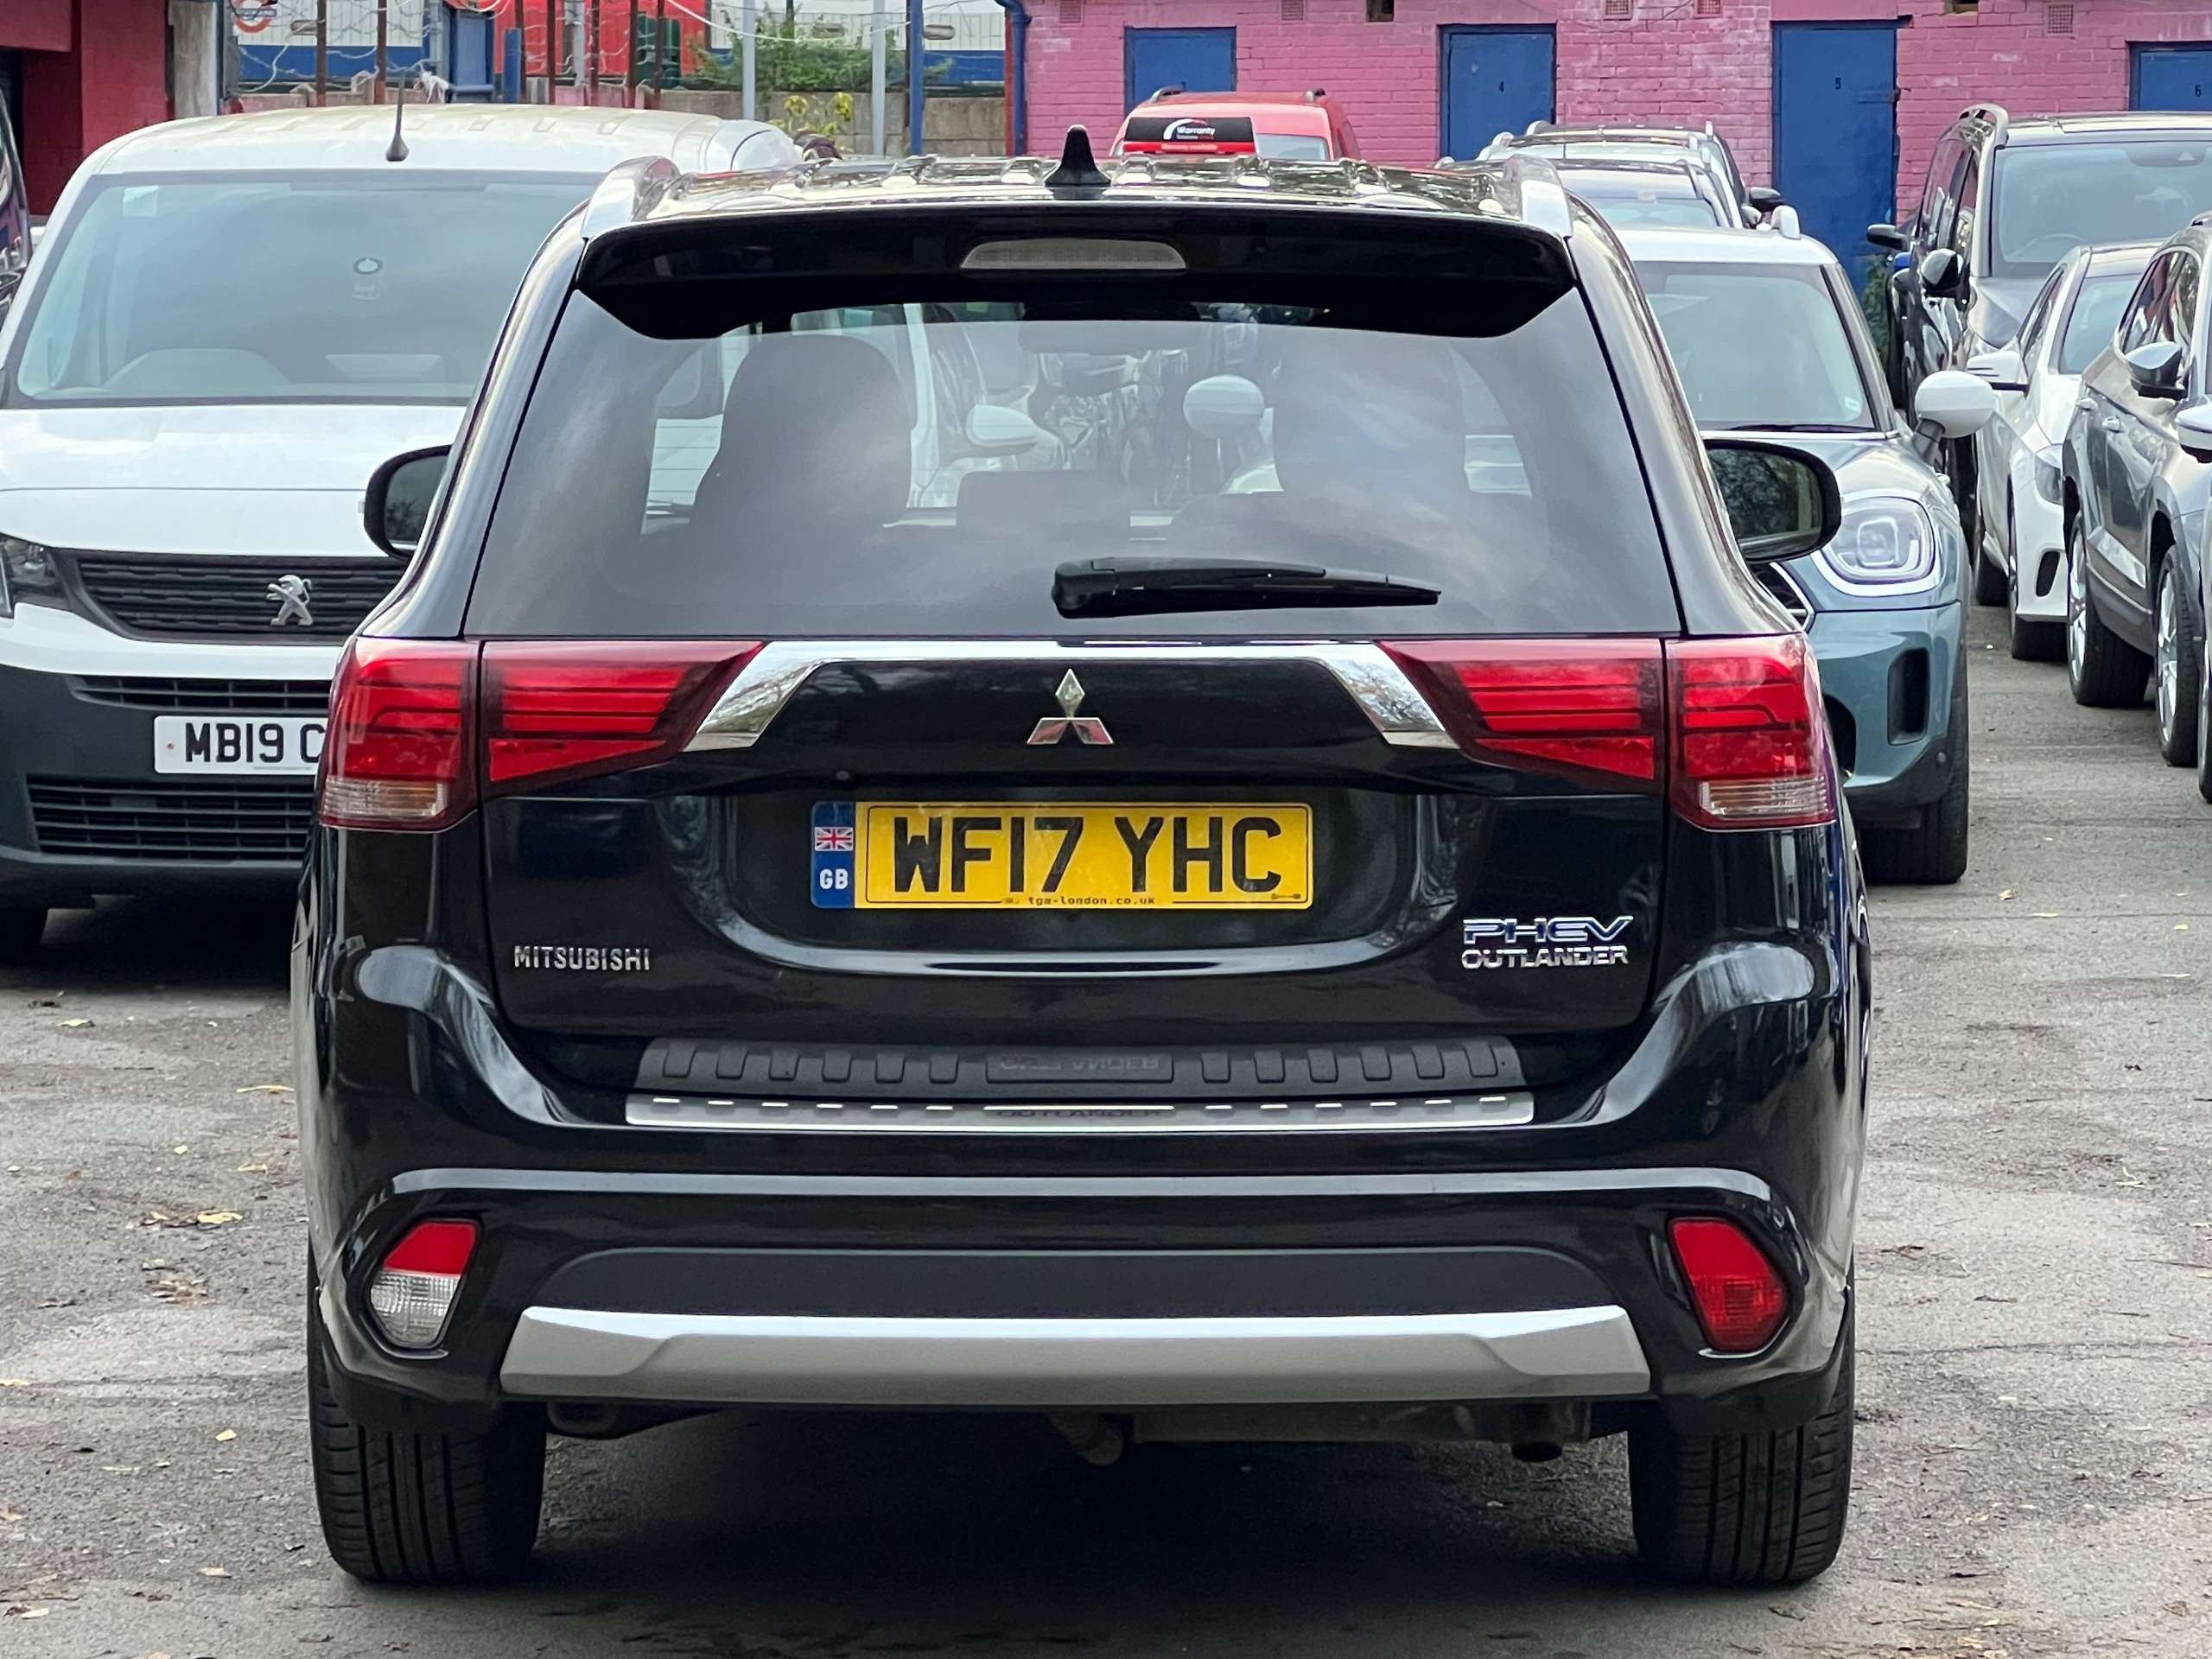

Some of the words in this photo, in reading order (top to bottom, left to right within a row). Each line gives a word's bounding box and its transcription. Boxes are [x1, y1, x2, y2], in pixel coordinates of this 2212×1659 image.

[1498, 80, 1504, 93] 4
[1834, 77, 1841, 90] 5
[2195, 84, 2202, 98] 6
[185, 722, 284, 763] MB19
[894, 817, 1084, 893] WF17
[1115, 817, 1281, 893] YHC
[819, 868, 849, 890] GB
[1028, 895, 1155, 906] tga-london.co.uk
[1463, 916, 1634, 944] PHEV
[514, 945, 650, 971] MITSUBISHI
[1461, 945, 1629, 969] OUTLANDER
